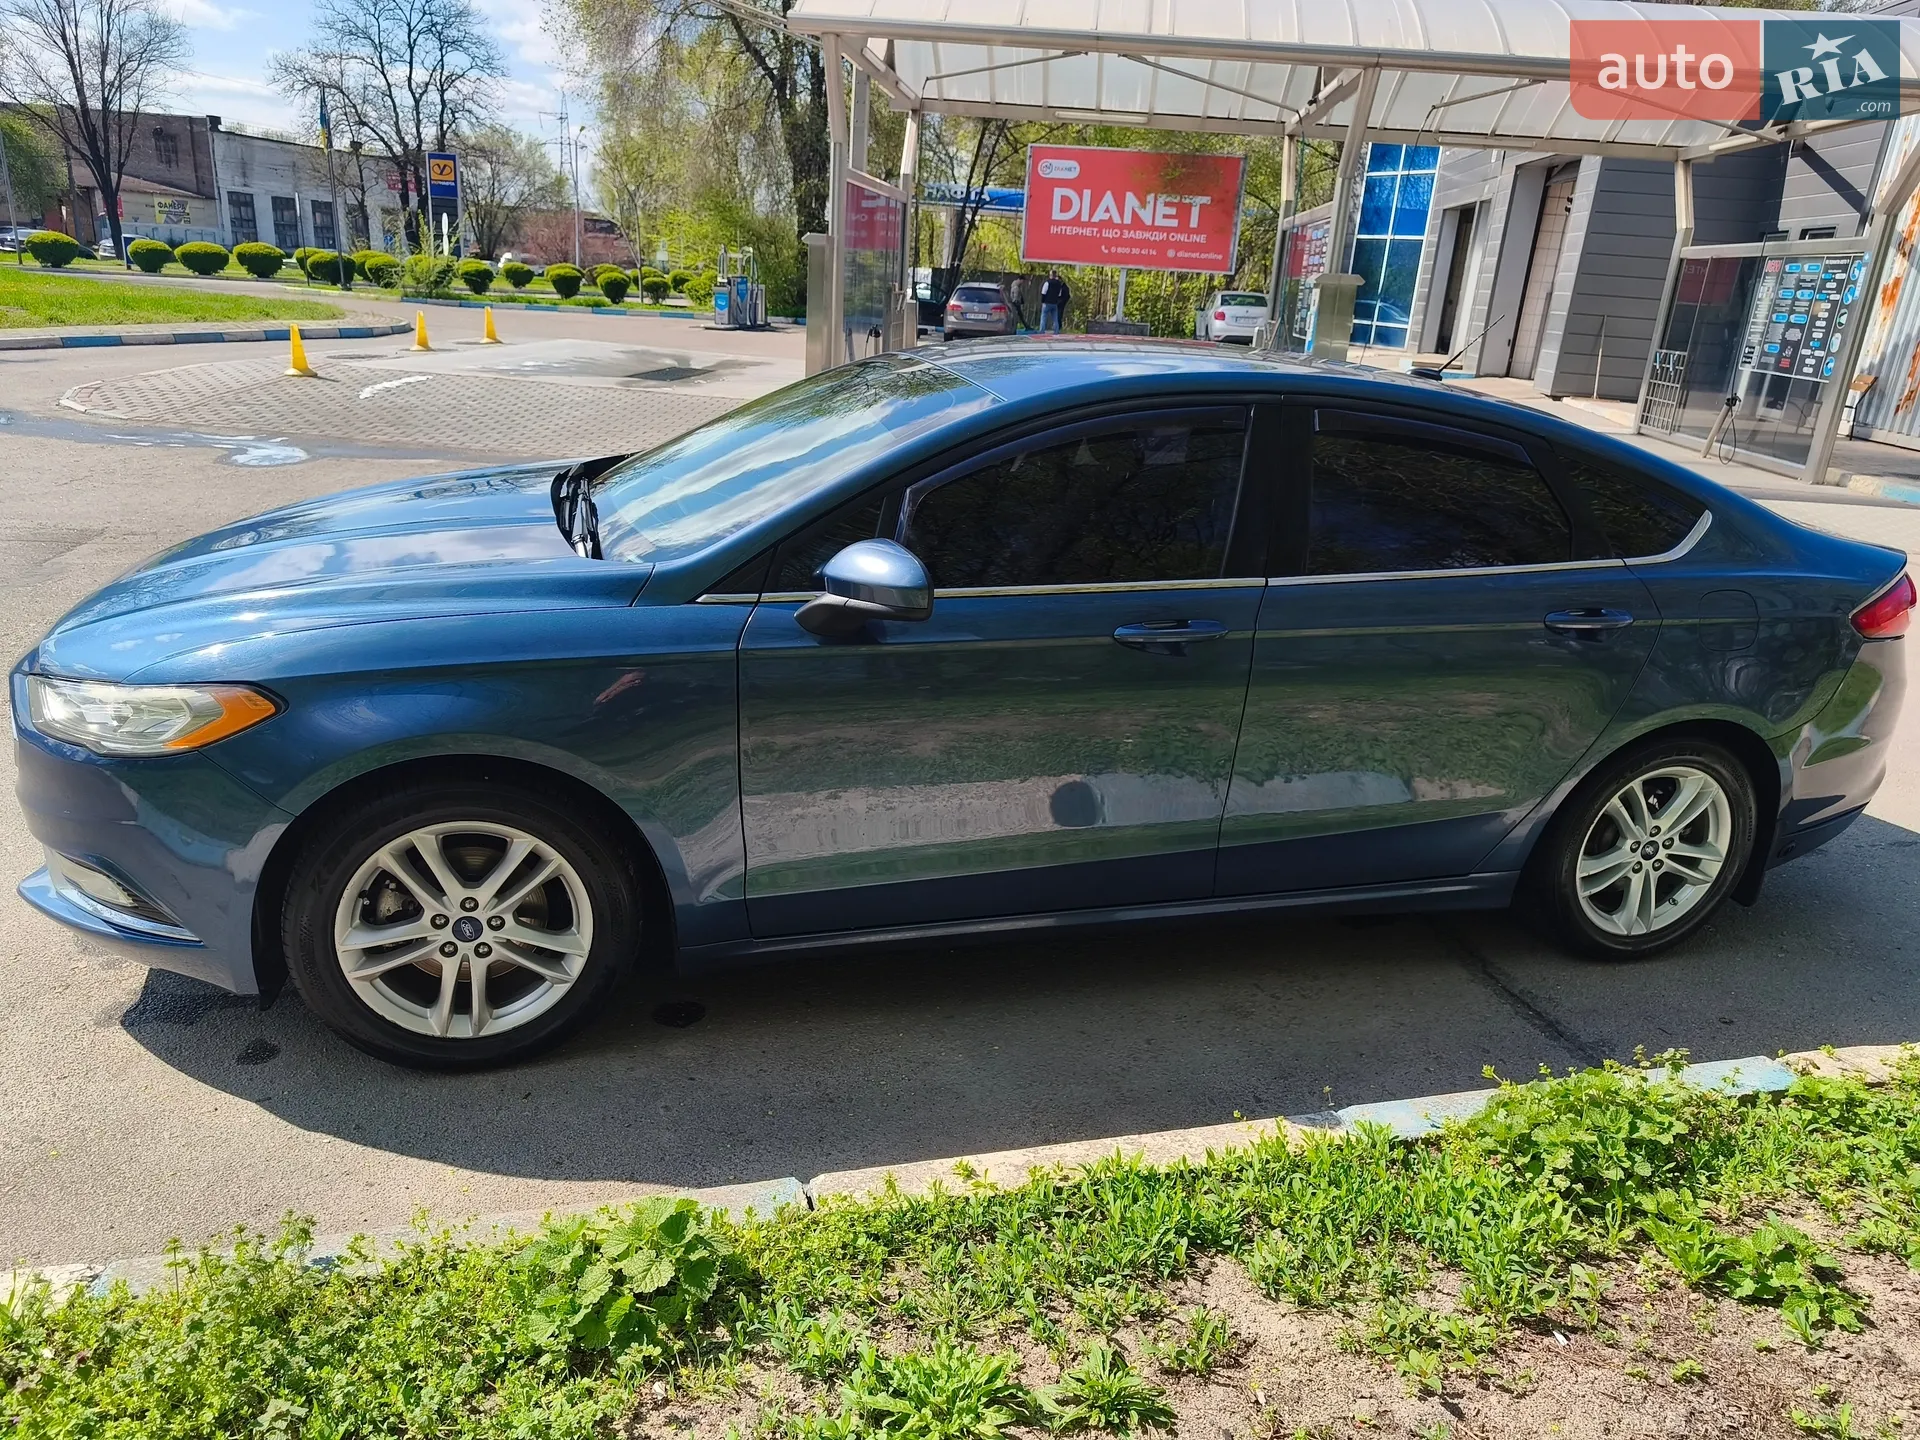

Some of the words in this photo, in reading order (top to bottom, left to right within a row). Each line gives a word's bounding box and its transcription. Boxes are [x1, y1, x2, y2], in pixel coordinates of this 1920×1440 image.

[1051, 187, 1212, 229] DIANET
[1050, 225, 1100, 238] ІНТЕРНЕТ,
[1102, 228, 1121, 239] ЩО
[1122, 230, 1167, 242] ЗАВЖДИ
[1169, 232, 1207, 243] ONLINE
[1177, 250, 1223, 260] dianet.online
